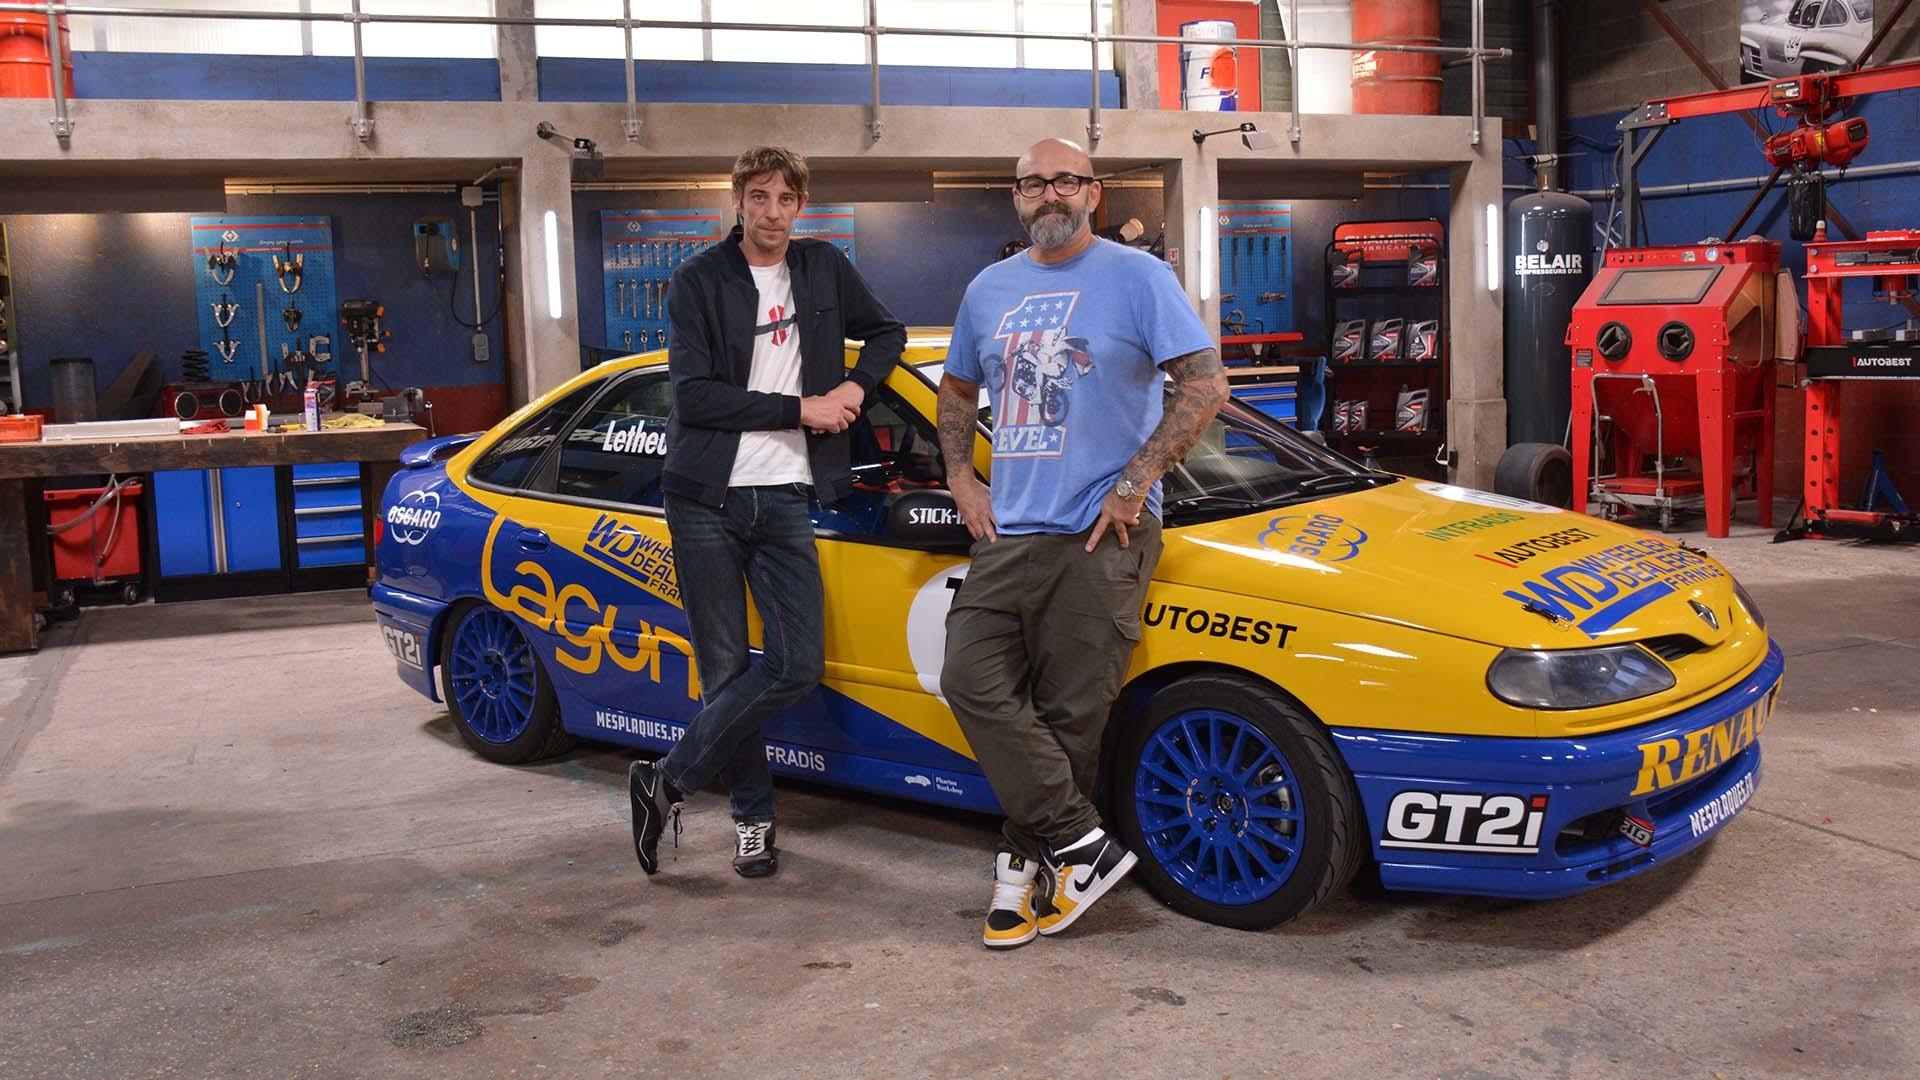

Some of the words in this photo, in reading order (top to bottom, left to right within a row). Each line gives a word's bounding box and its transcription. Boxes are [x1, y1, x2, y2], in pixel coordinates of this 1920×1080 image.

[1514, 254, 1582, 269] BELAIR
[1856, 358, 1912, 367] AUTOBEST
[587, 513, 641, 559] WD
[1287, 514, 1345, 557] SCARO
[1494, 528, 1598, 563] AUTOBEST
[631, 551, 678, 587] DEAL
[1503, 565, 1619, 622] WD
[1569, 539, 1674, 574] WHEELER
[1608, 551, 1706, 588] DEALERS
[1663, 565, 1724, 590] FRANCE
[1140, 602, 1297, 649] UTOBEST
[383, 625, 422, 666] GT2i
[1386, 791, 1547, 846] GT2i
